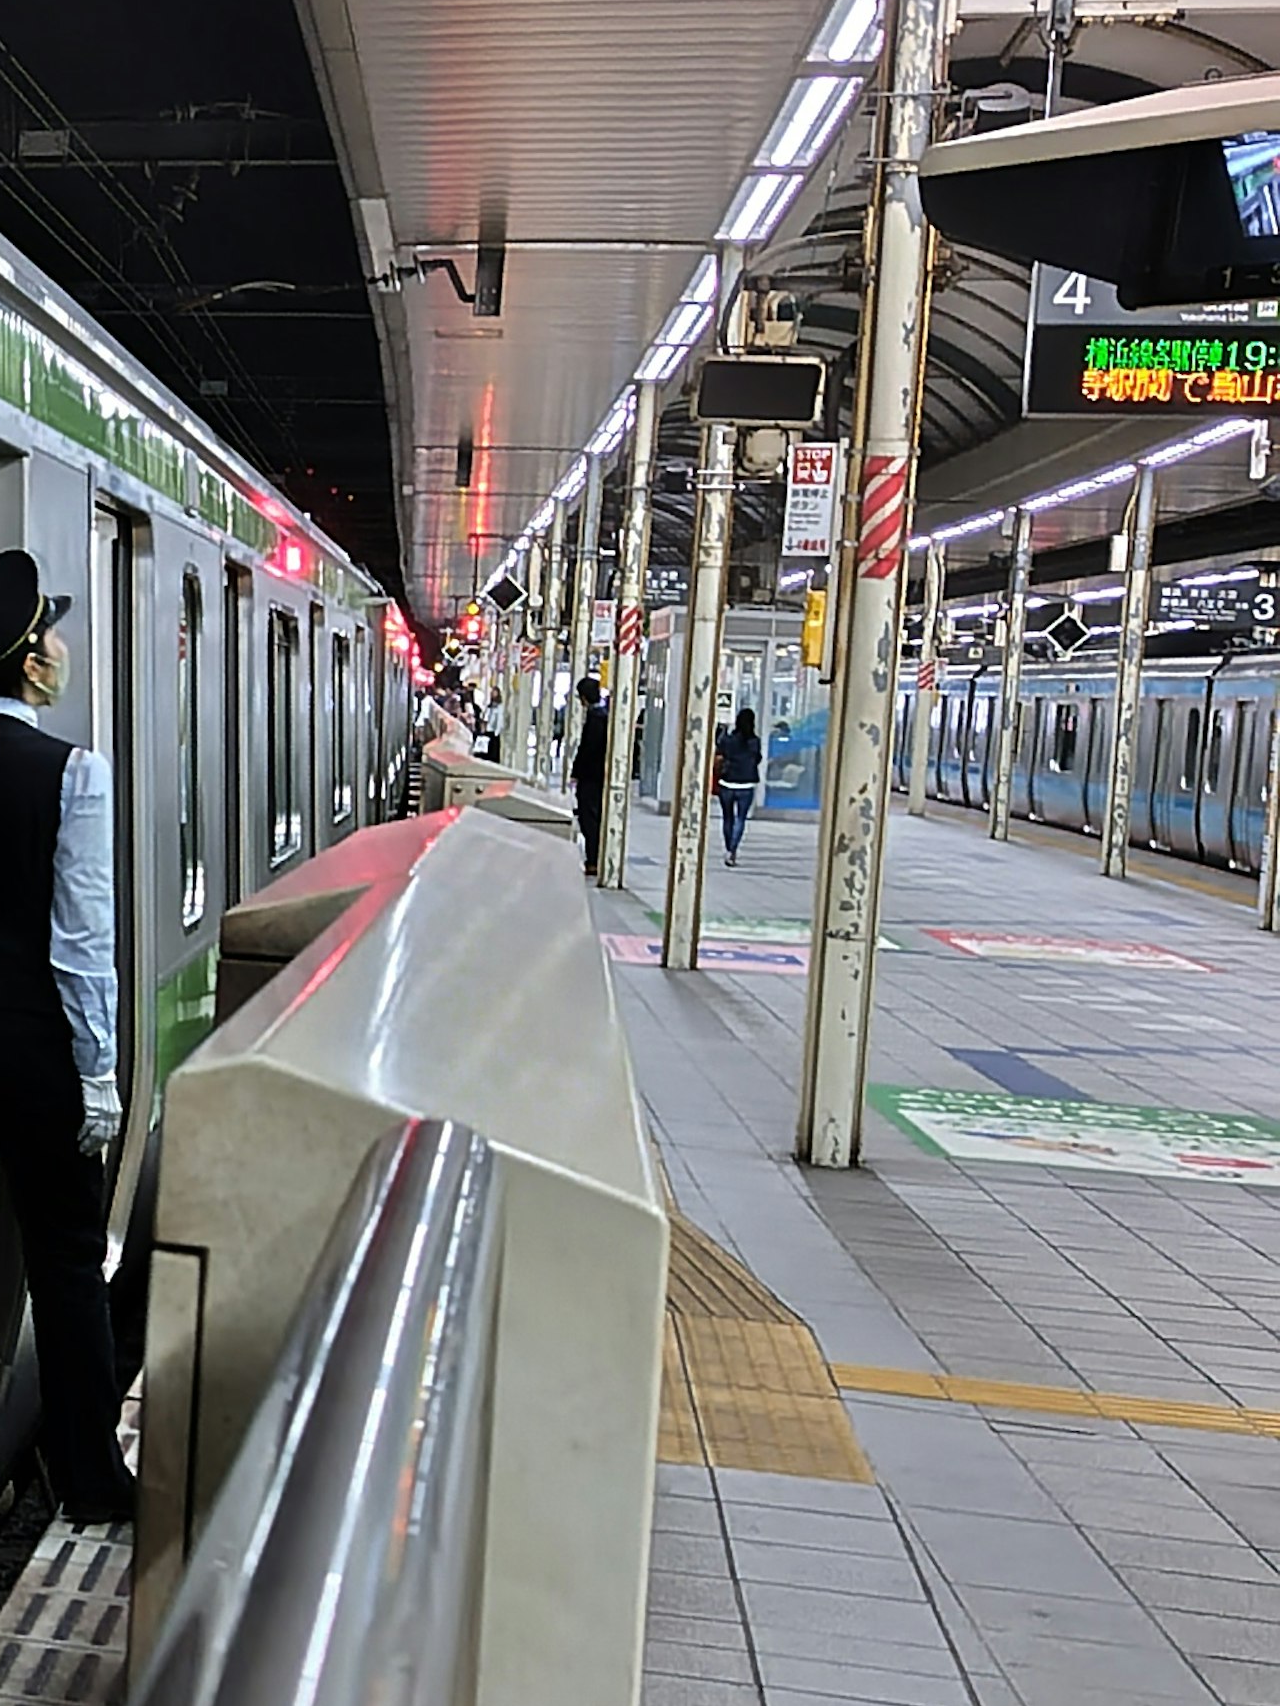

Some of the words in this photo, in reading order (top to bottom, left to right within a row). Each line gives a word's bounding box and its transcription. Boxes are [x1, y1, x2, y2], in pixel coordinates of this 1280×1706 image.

[1053, 272, 1091, 315] 4
[1226, 340, 1280, 371] 19:
[796, 449, 831, 460] STOP
[1252, 593, 1275, 620] 3
